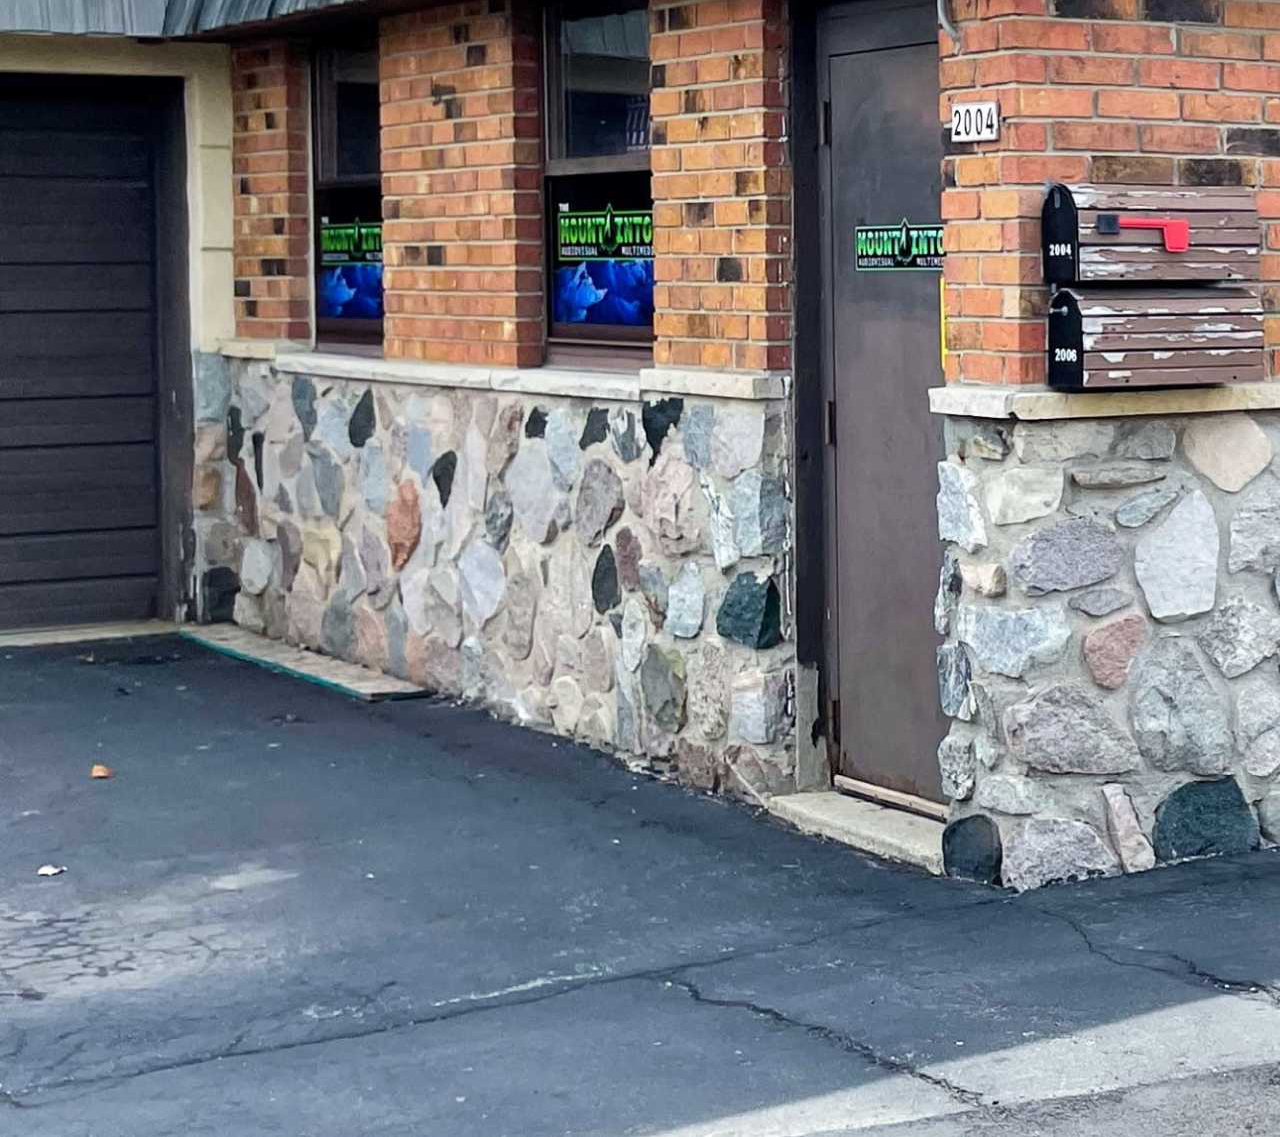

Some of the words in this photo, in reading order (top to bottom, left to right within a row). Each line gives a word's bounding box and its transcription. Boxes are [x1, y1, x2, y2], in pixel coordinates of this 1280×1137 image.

[953, 108, 995, 137] 2004
[560, 213, 652, 244] MOUNTAINTO
[857, 227, 944, 256] MOUNTAINTO
[1049, 243, 1072, 257] 2004
[1054, 347, 1078, 362] 2006
